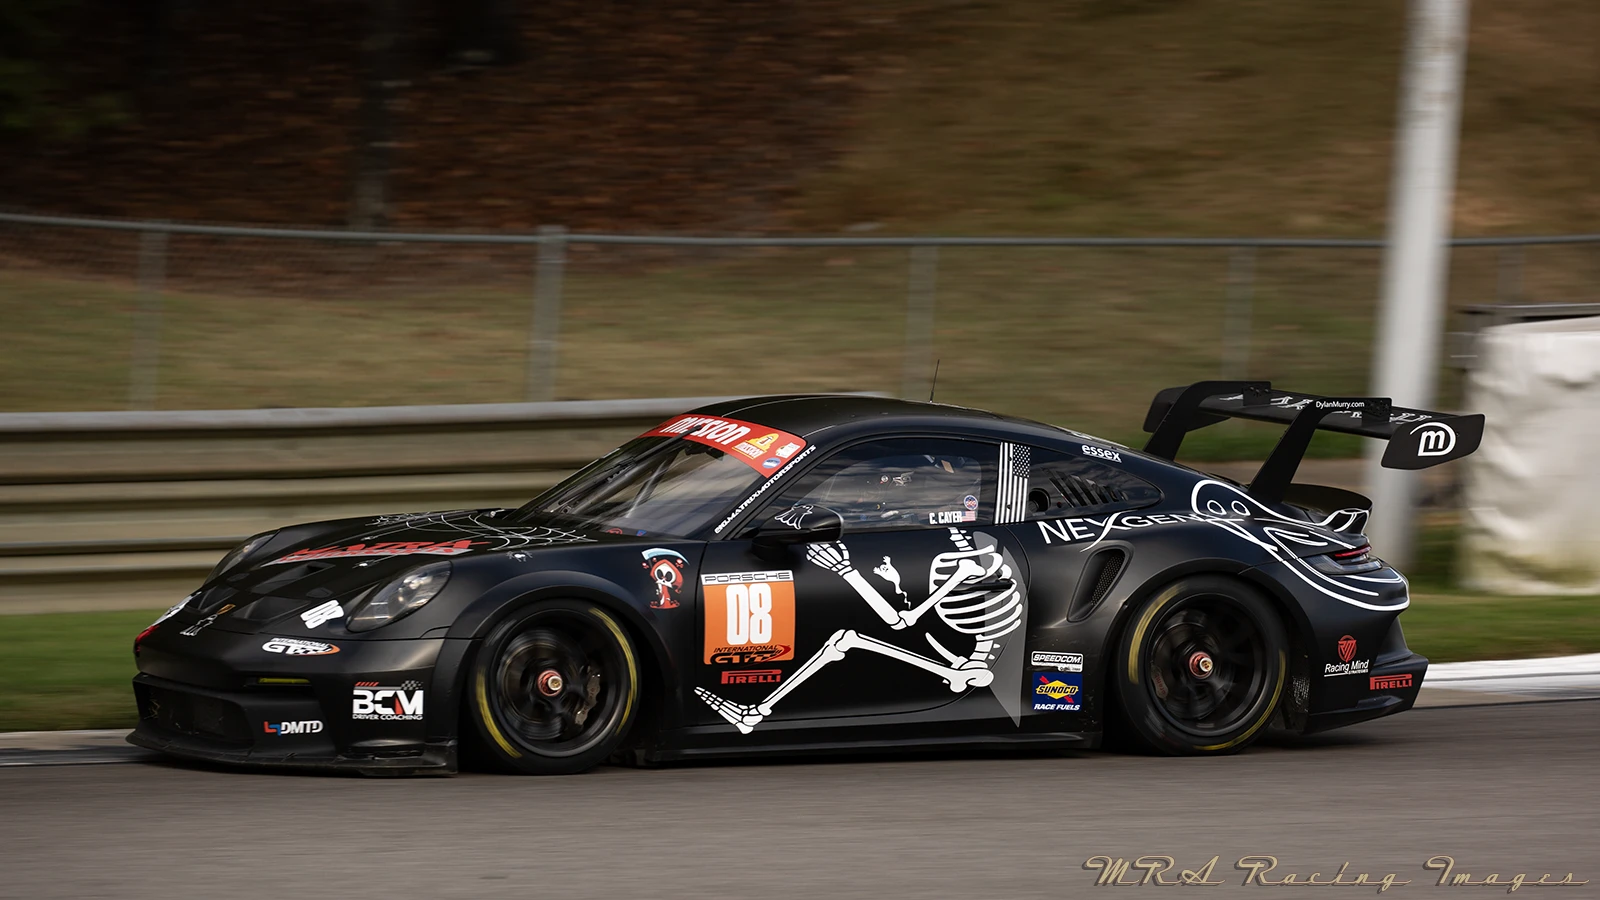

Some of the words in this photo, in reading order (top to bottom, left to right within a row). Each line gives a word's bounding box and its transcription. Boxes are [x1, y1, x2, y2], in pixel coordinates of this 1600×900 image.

[1315, 401, 1365, 410] DylanMurry.com
[1081, 444, 1122, 463] essex
[929, 512, 938, 525] C.
[938, 510, 963, 524] CAYER
[704, 572, 791, 584] PORSCHE
[300, 600, 345, 629] 08
[726, 583, 773, 645] 08
[713, 645, 779, 653] INTERNATIONAL
[1033, 654, 1081, 663] SPEEDCOM
[1324, 662, 1350, 674] Racing
[1351, 659, 1370, 670] Mind
[721, 669, 782, 685] PIRELLI
[1370, 673, 1413, 690] PIRELLI
[1037, 685, 1077, 694] SUNOCO
[352, 690, 424, 714] BCM
